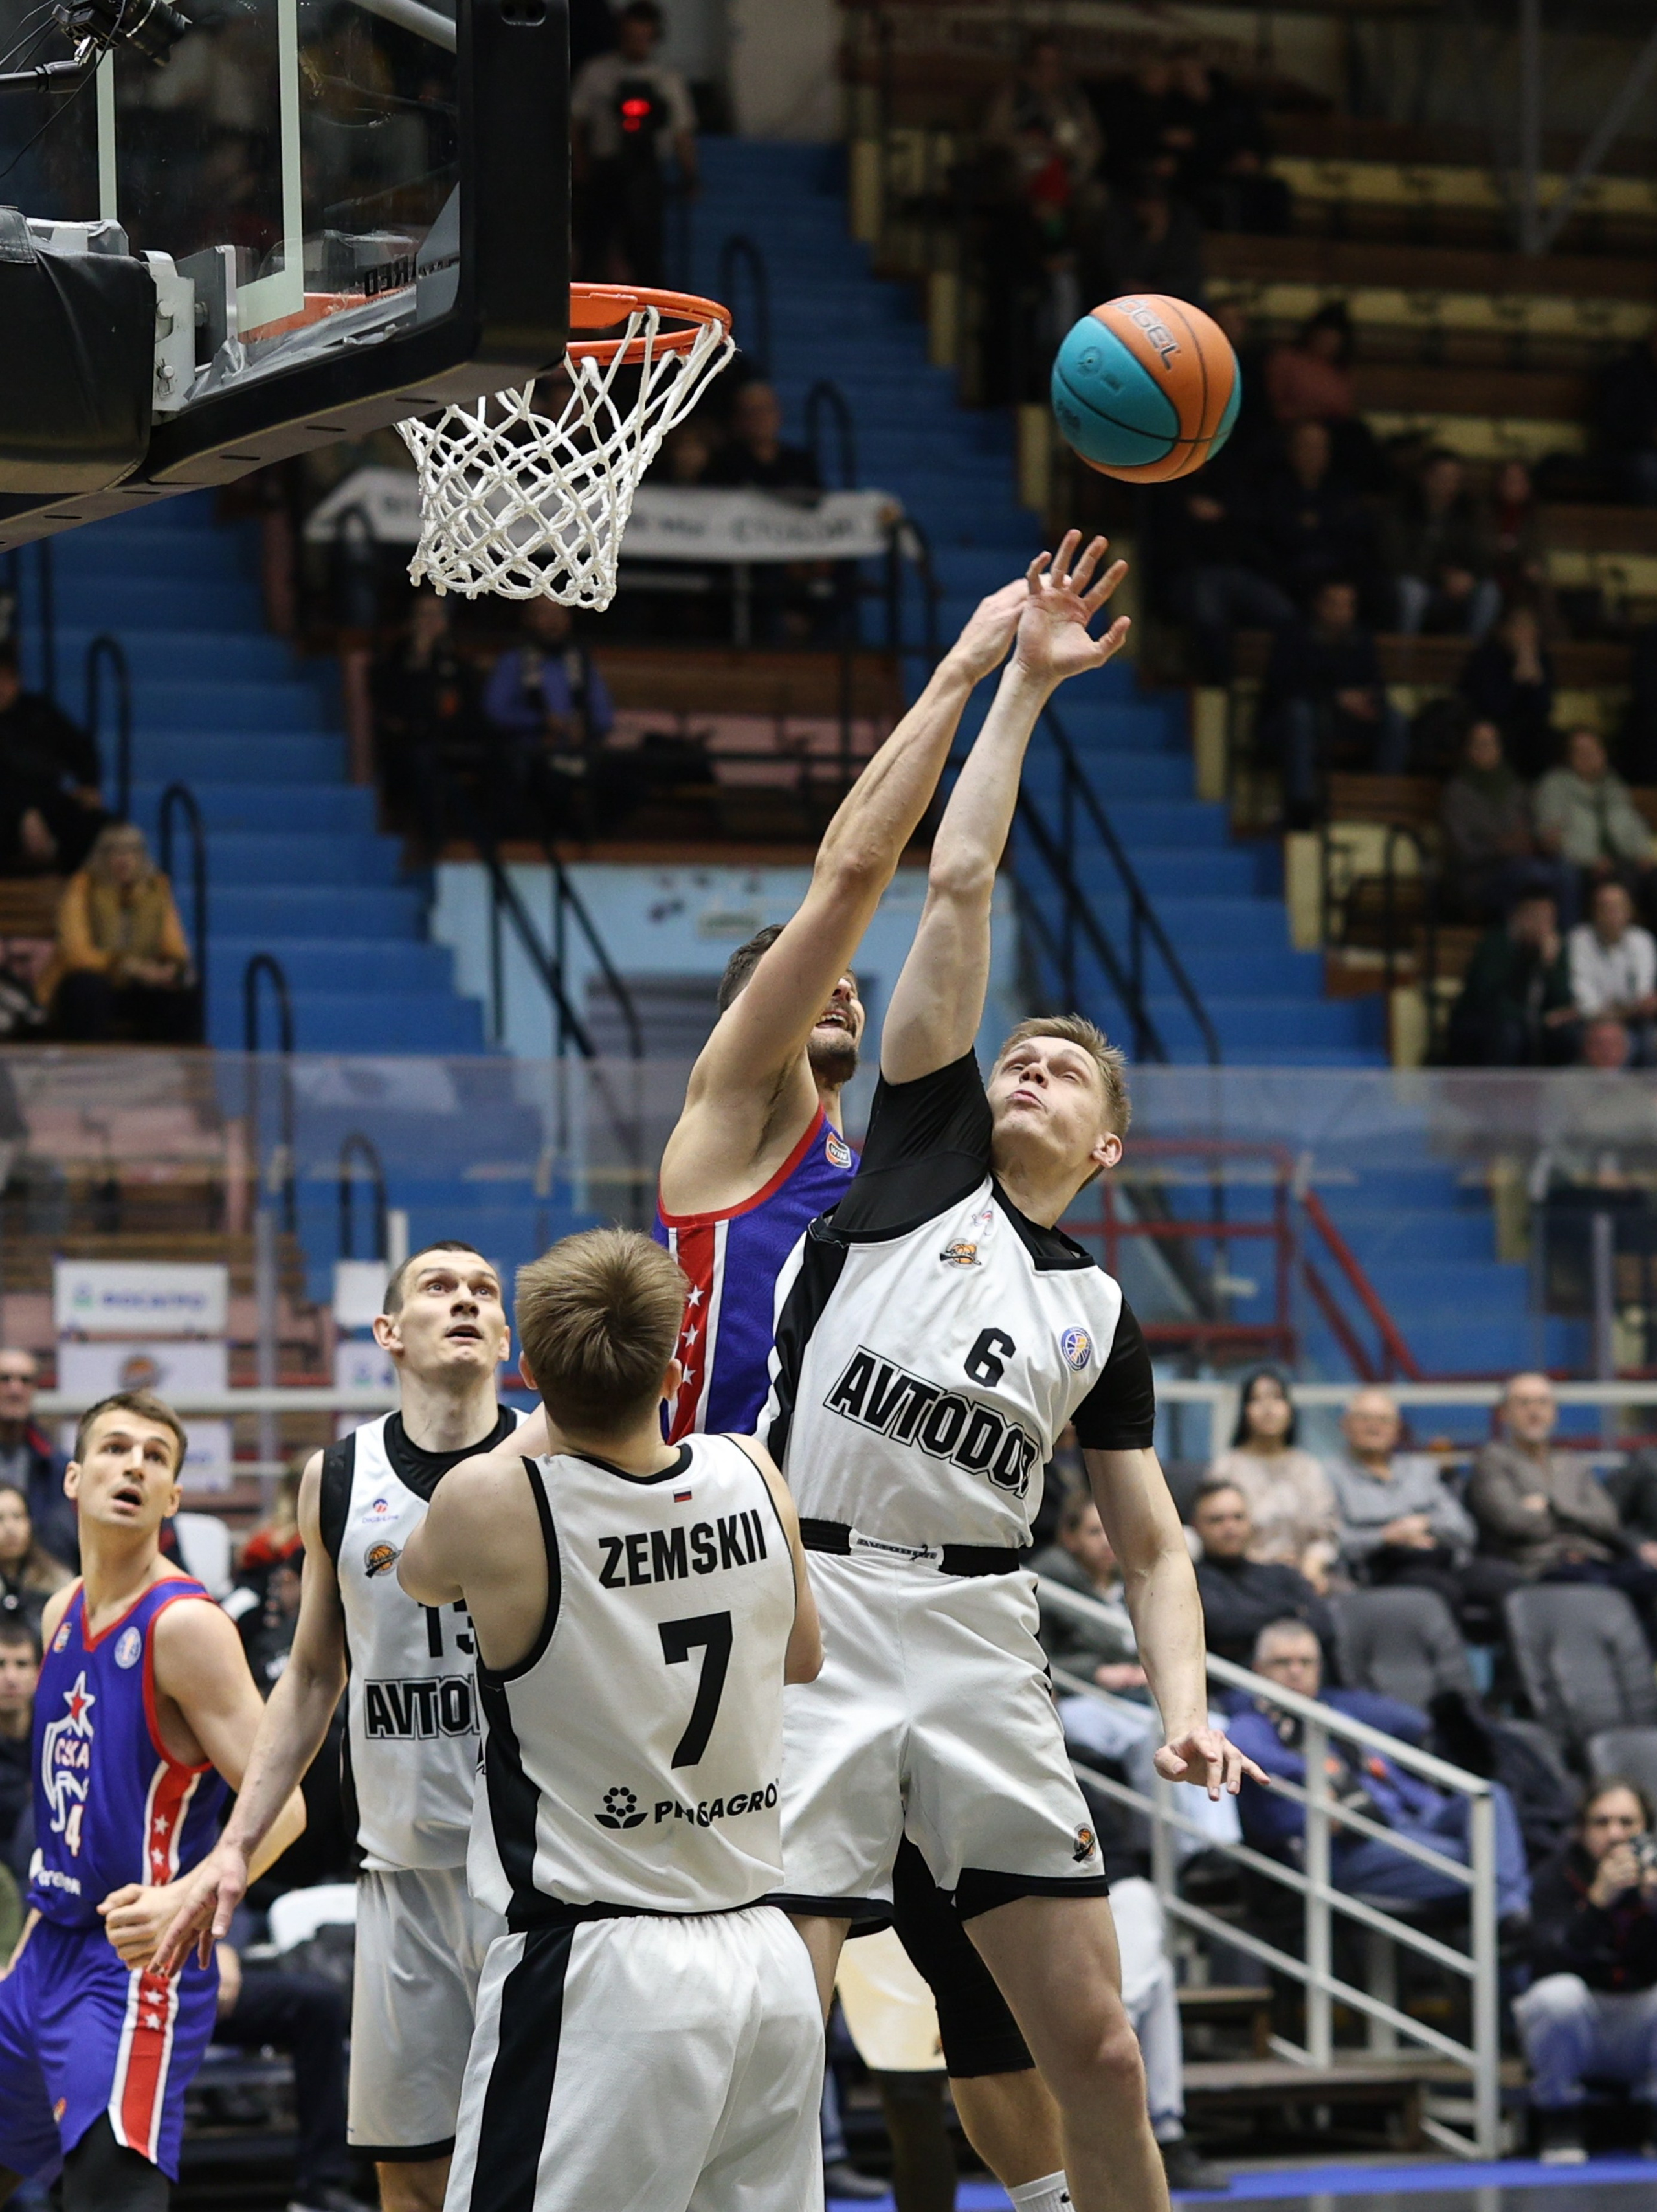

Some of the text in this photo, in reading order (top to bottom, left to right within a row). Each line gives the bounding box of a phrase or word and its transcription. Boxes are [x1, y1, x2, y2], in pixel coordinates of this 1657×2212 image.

[964, 1327, 1016, 1388] 6
[598, 1508, 768, 1589] ZEMSKII
[364, 1673, 481, 1741] AVTO
[658, 1610, 733, 1770] 7
